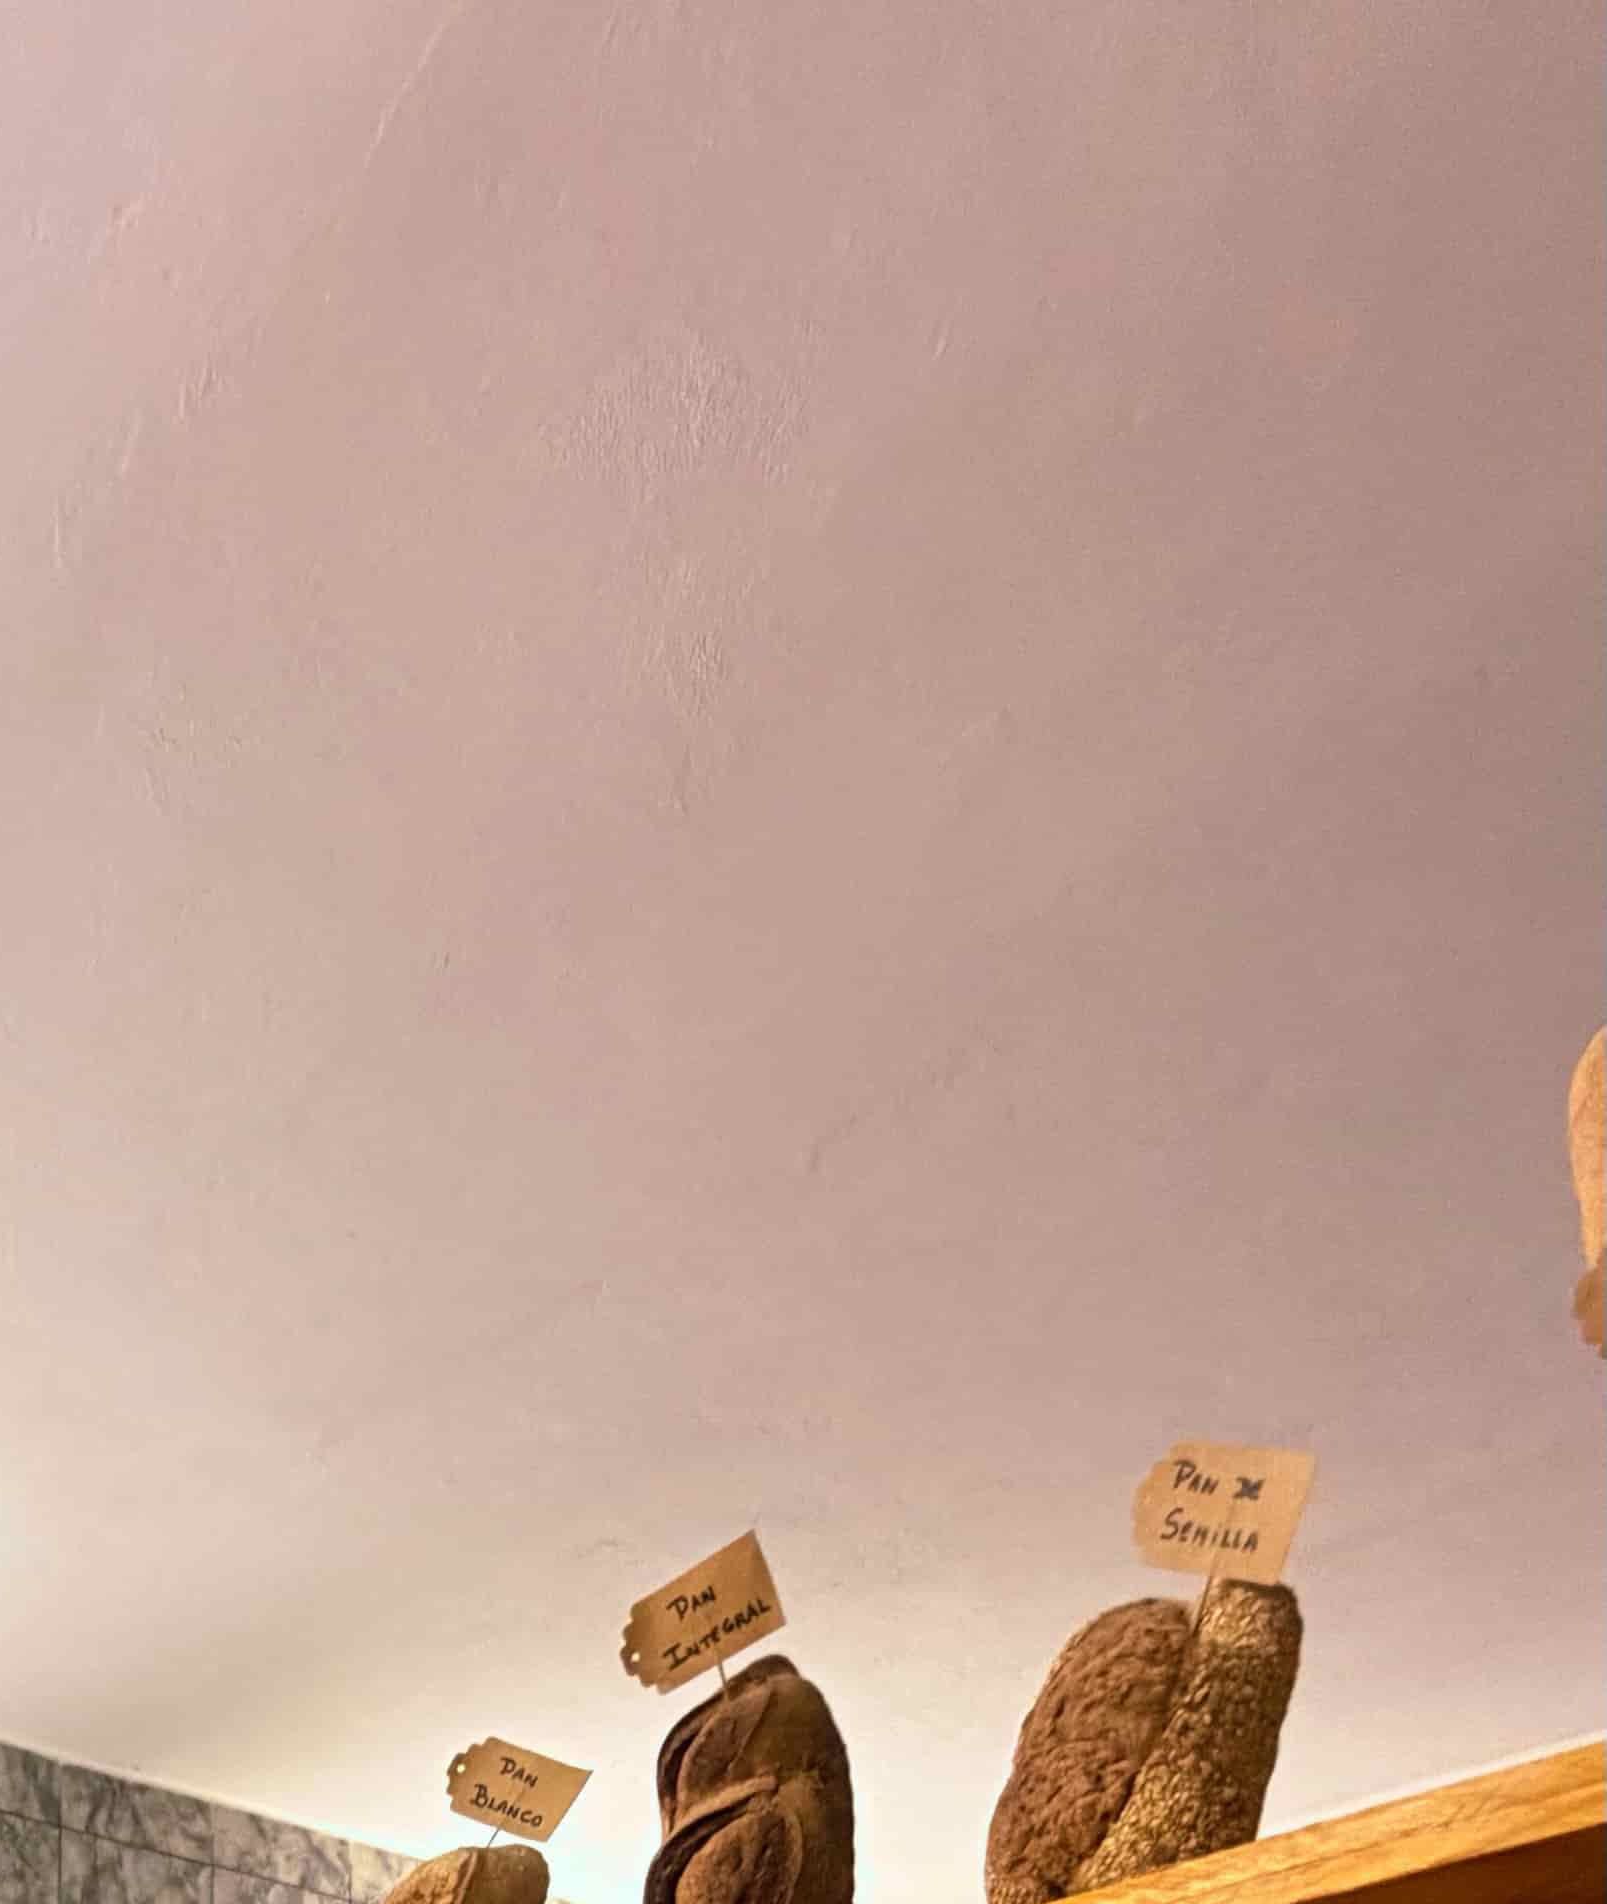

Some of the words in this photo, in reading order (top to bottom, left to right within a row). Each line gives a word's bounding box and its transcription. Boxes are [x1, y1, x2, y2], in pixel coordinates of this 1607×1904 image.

[1172, 1458, 1219, 1495] PAN
[665, 1585, 716, 1621] PAN
[661, 1595, 771, 1671] INTEGRAL
[500, 1756, 538, 1788] PAN
[469, 1783, 543, 1828] BLANCO
